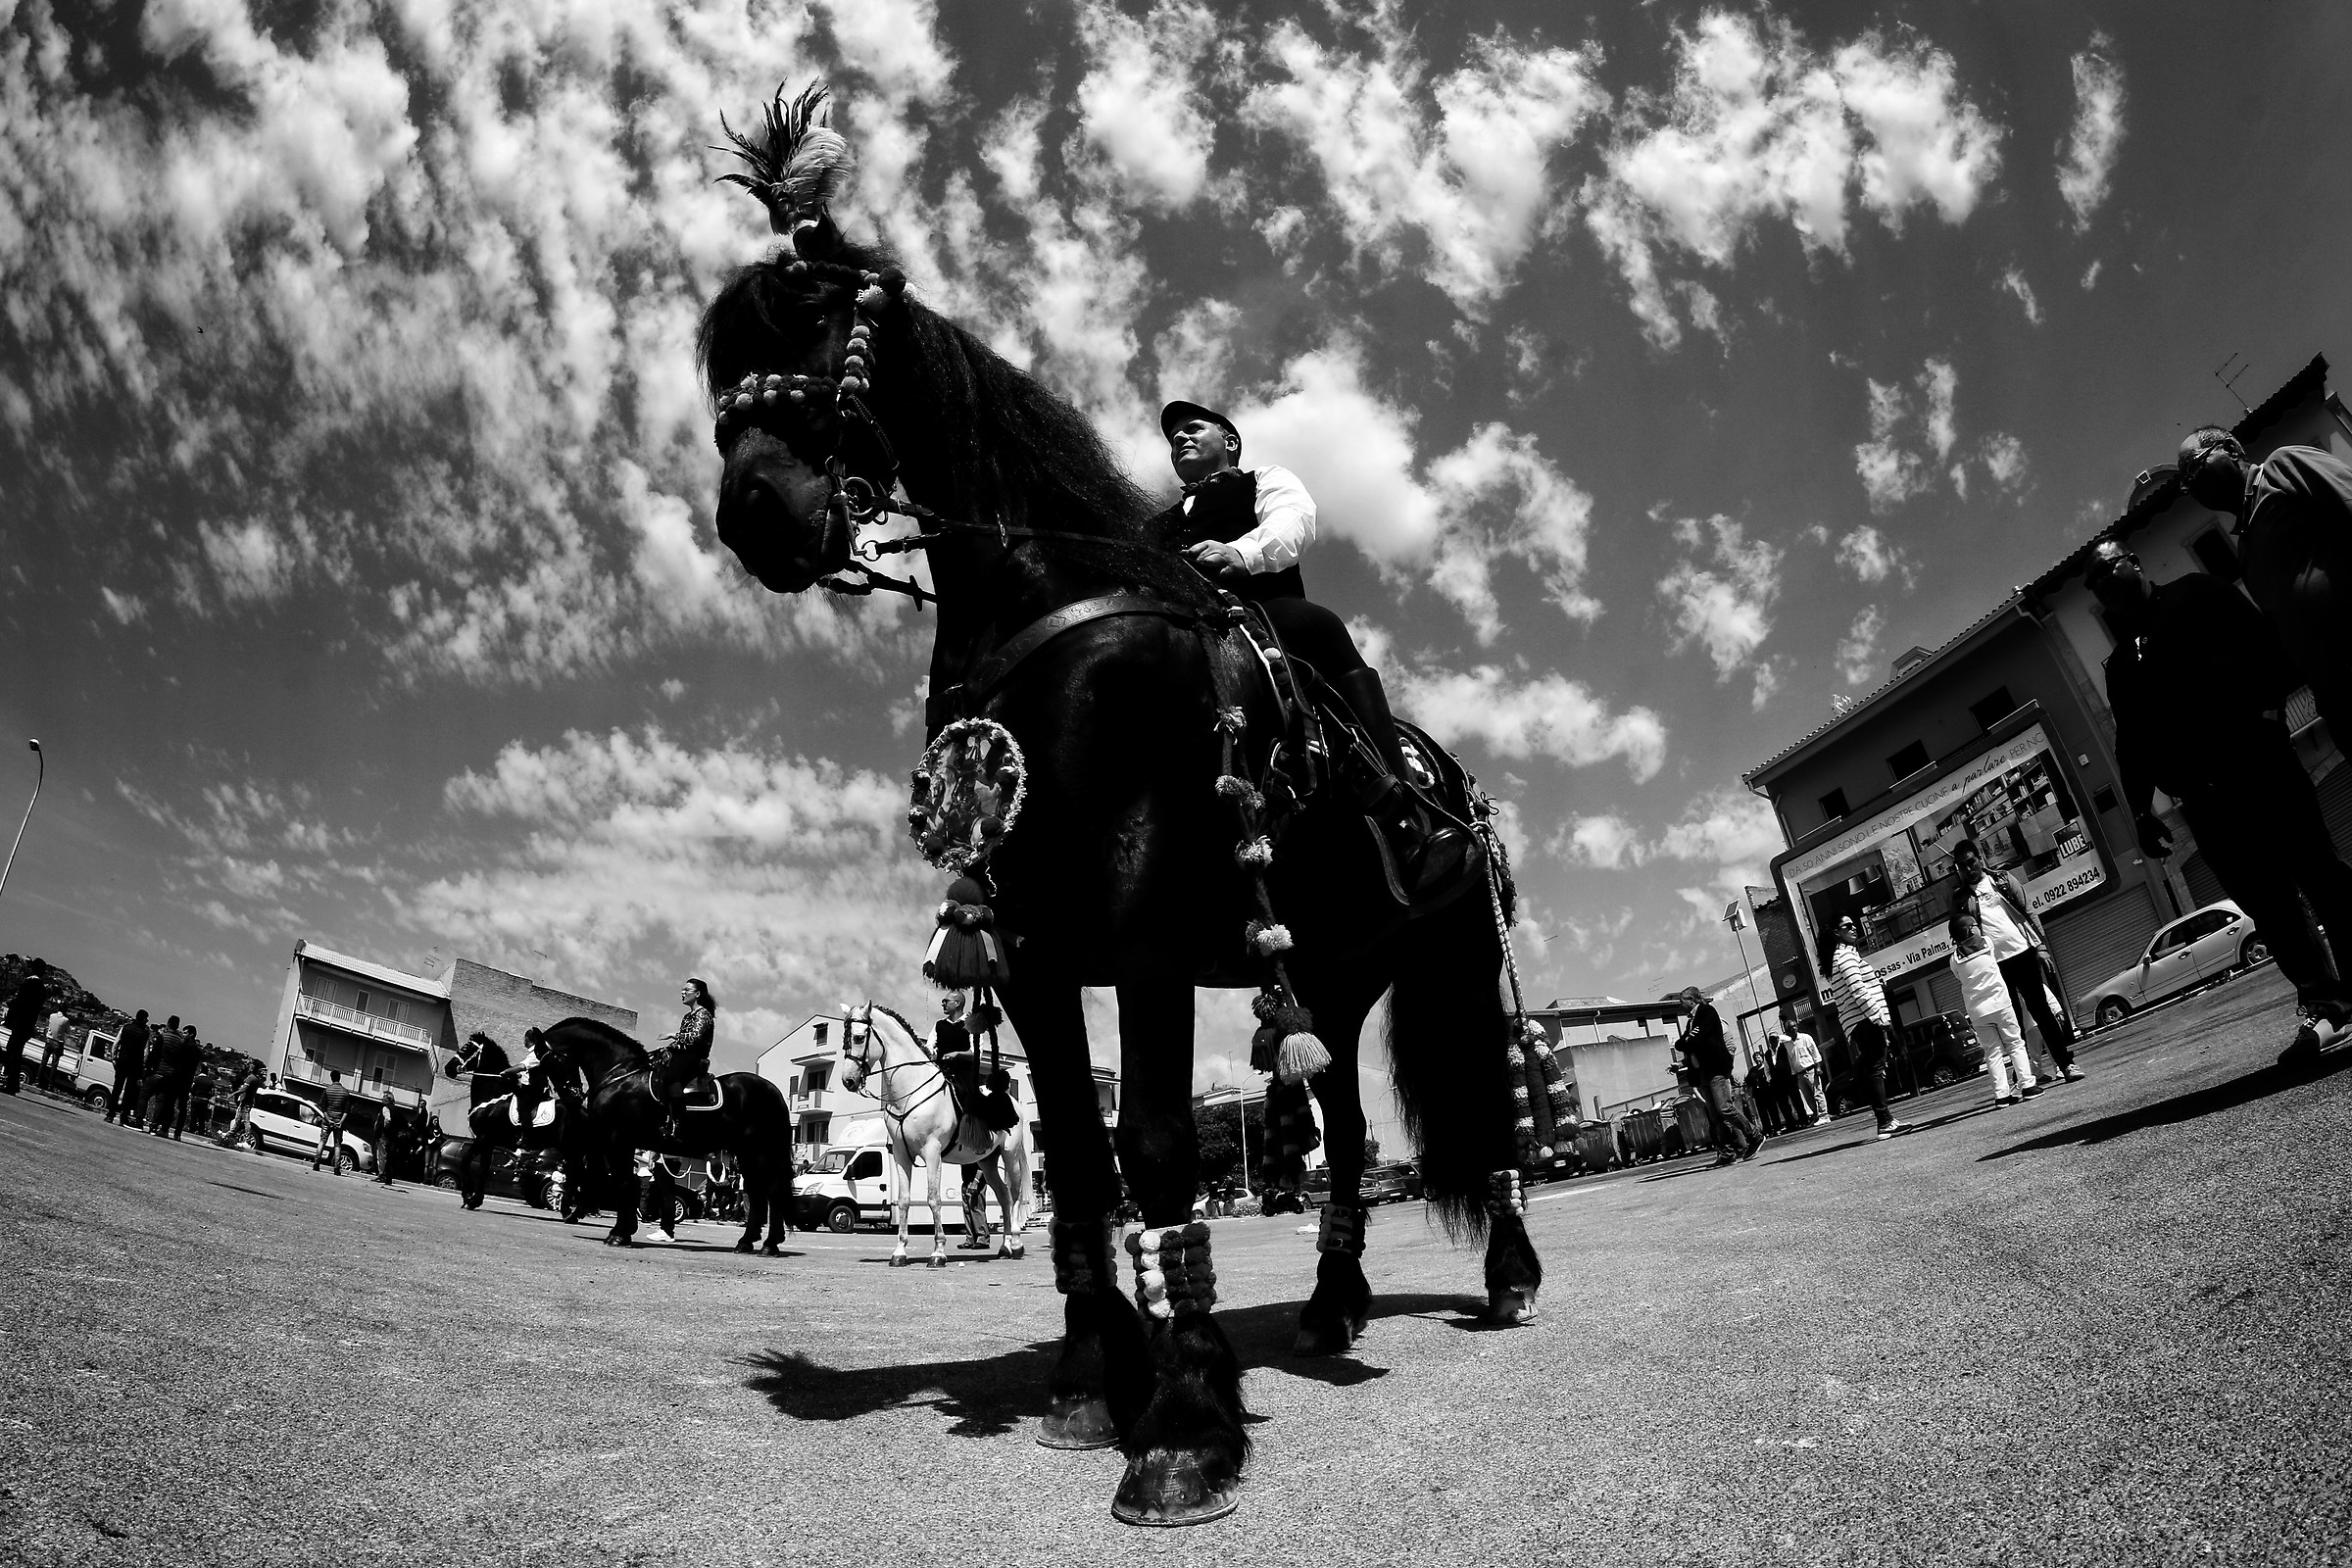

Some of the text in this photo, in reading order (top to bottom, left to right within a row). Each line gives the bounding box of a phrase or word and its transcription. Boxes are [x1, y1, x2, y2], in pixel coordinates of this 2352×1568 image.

[1788, 866, 1802, 878] DA
[1815, 848, 1838, 864] ANNI
[1838, 832, 1865, 852] SONO
[1866, 824, 1879, 837] LE
[1879, 806, 1914, 828] NOSTRE
[1915, 786, 1949, 810] CUCINE
[1961, 755, 2006, 796] parlare
[2009, 743, 2027, 759] PER
[2059, 833, 2086, 858] LUBE
[2032, 866, 2100, 909] el. 0922 894234
[1906, 952, 1921, 964] Via
[1921, 942, 1950, 958] Palma,
